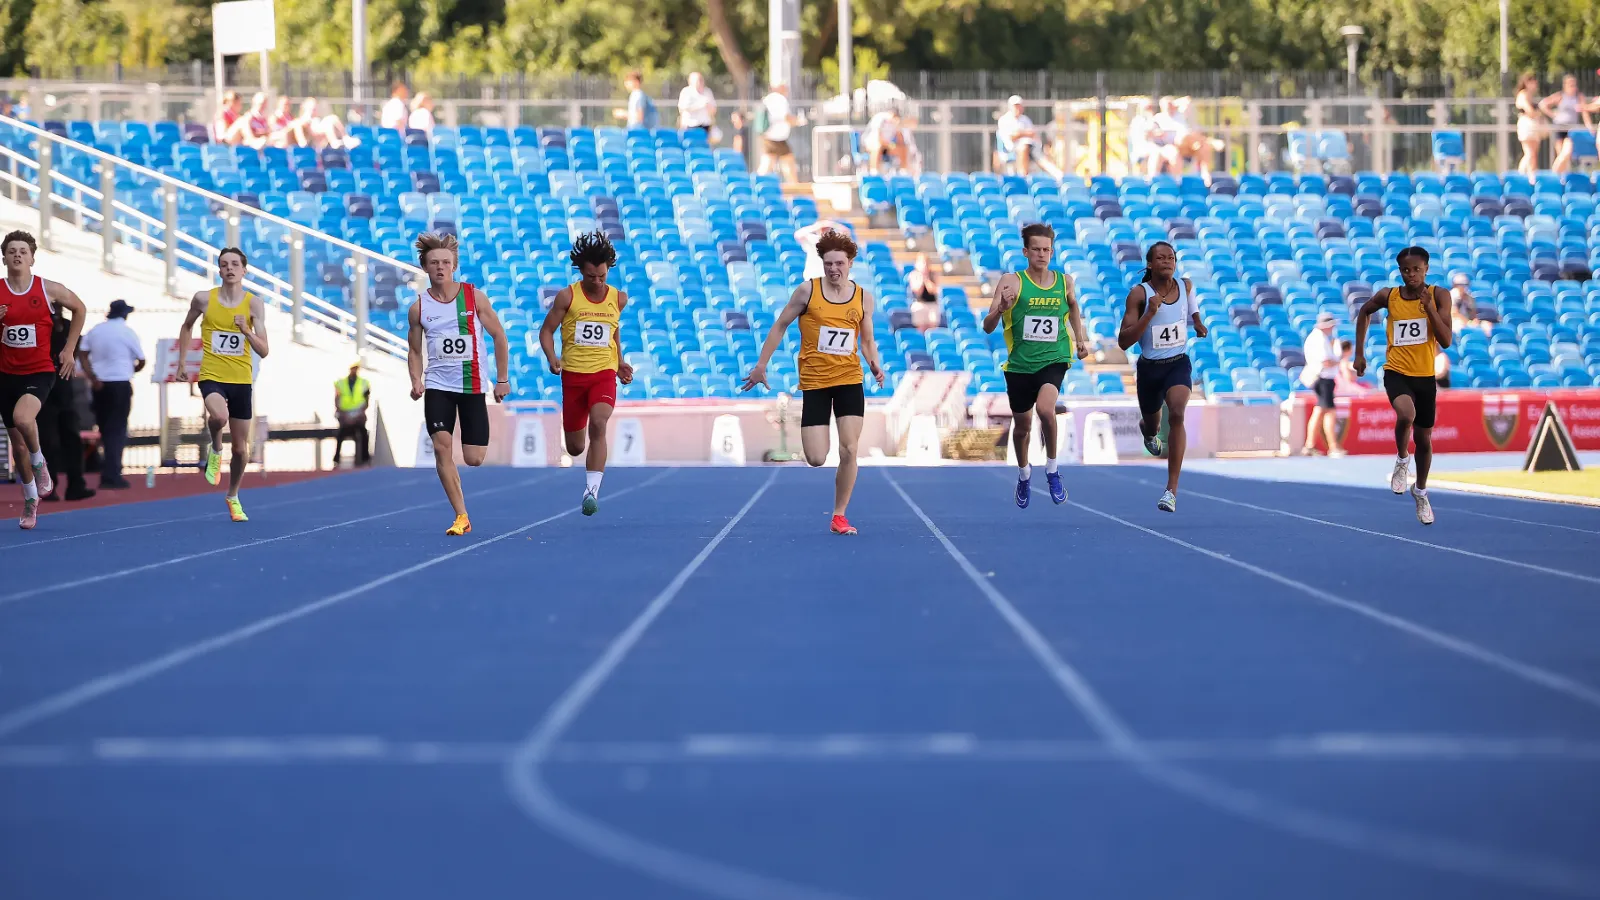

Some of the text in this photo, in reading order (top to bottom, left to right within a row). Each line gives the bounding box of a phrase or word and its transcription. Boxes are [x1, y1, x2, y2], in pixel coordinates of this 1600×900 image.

[1028, 297, 1061, 306] STAFFS
[6, 327, 29, 341] 69
[582, 324, 604, 340] 59
[1031, 319, 1053, 334] 73
[1159, 325, 1179, 341] 41
[1398, 322, 1421, 338] 78
[219, 334, 240, 349] 79
[442, 338, 466, 354] 89
[827, 330, 850, 347] 77
[523, 433, 536, 455] 8
[624, 433, 634, 453] 7
[722, 435, 733, 453] 6
